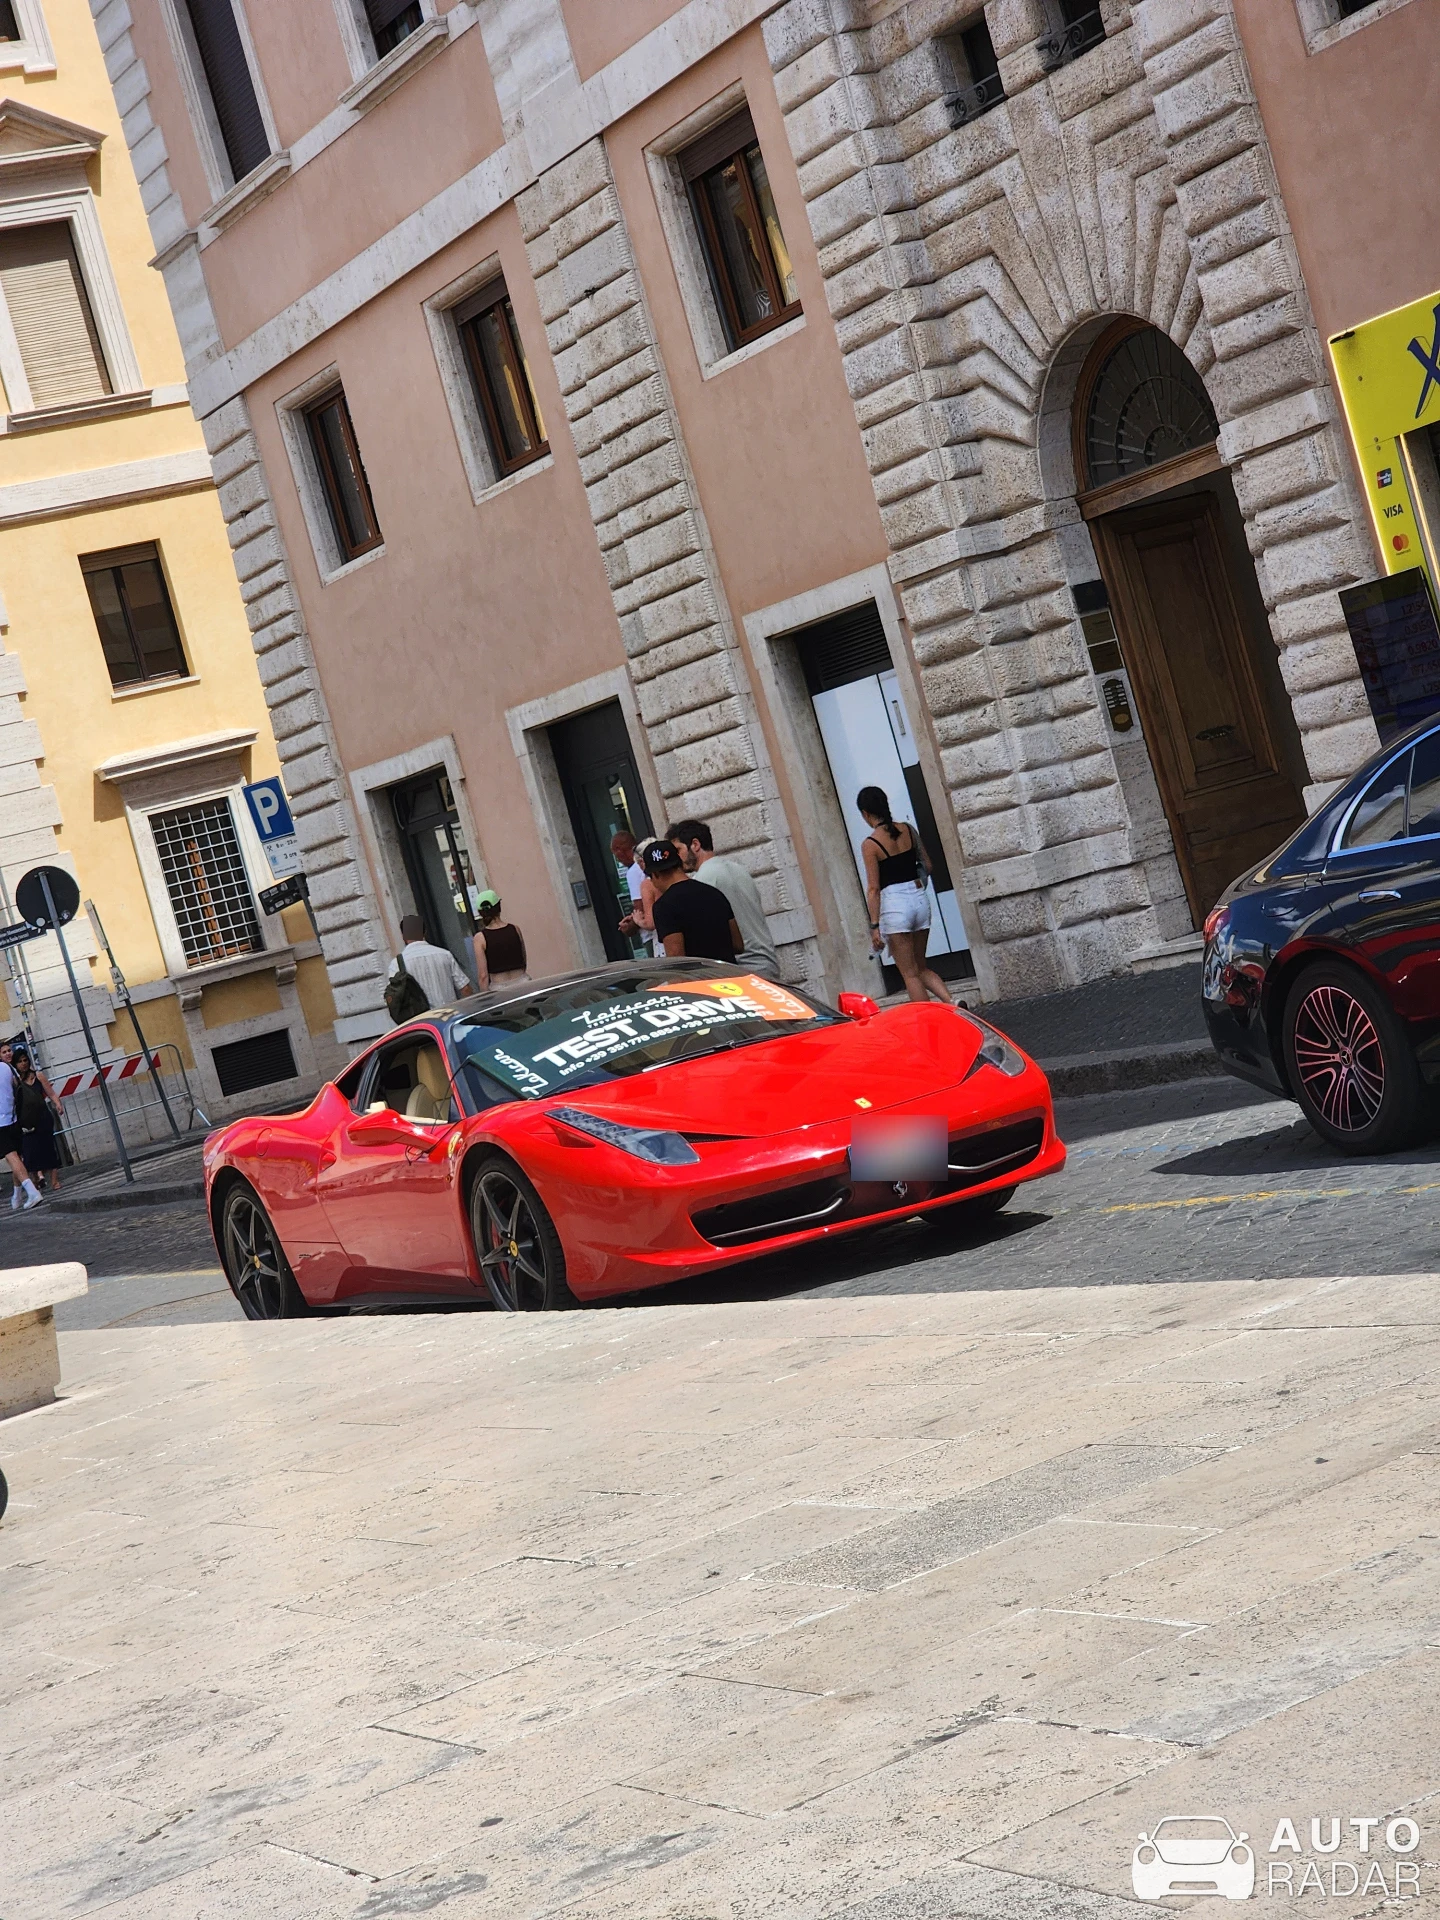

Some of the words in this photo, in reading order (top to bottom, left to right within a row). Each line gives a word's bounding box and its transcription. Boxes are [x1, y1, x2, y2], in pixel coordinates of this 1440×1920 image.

[1383, 503, 1404, 518] VISA
[251, 787, 279, 834] P
[532, 1018, 639, 1067] TEST
[640, 996, 766, 1028] DRIVE
[559, 1061, 585, 1076] Info
